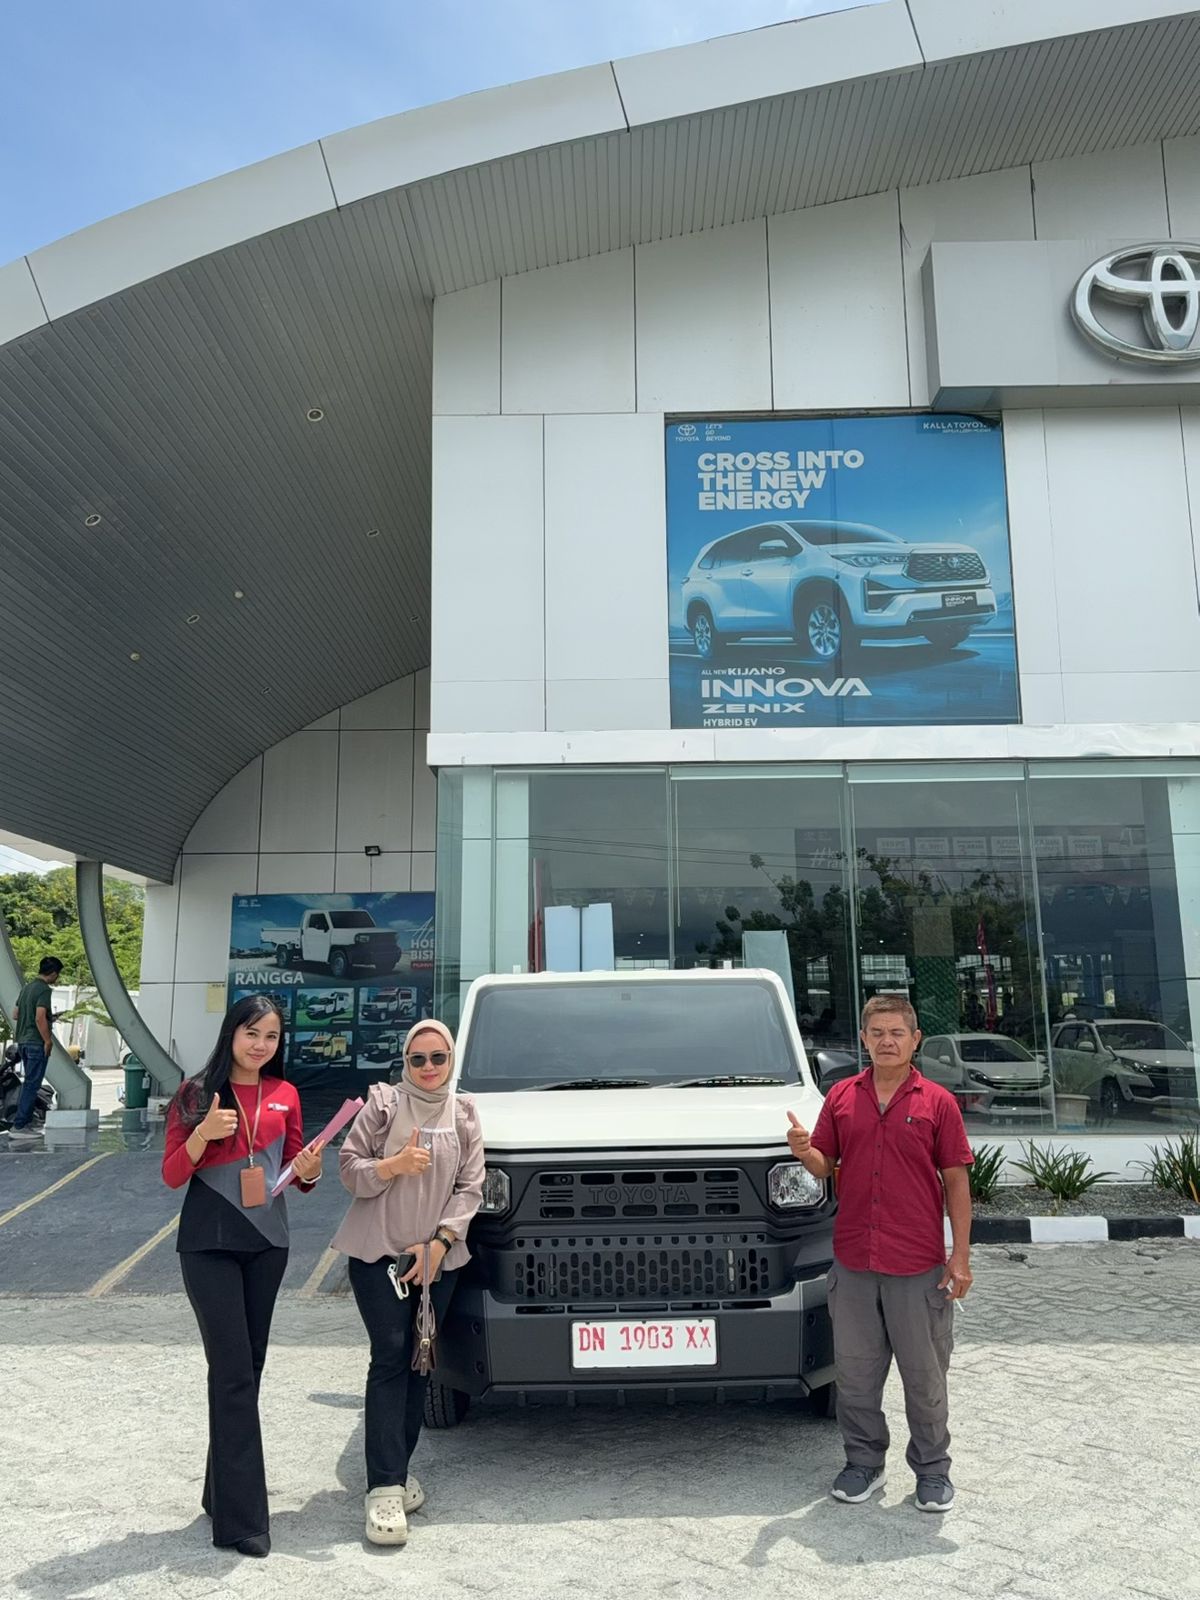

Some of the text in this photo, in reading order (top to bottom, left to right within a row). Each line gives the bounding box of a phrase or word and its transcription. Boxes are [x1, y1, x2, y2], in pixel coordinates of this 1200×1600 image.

[697, 449, 865, 471] CROSS INTO
[697, 470, 826, 491] THE NEW
[698, 490, 811, 511] ENERGY
[727, 667, 786, 676] KIJANG
[701, 678, 873, 698] INNOVA
[702, 702, 806, 714] ZENIX
[703, 718, 758, 727] HYBRID EV
[234, 971, 305, 985] RANGGA
[589, 1185, 690, 1204] TOYOTA
[578, 1325, 711, 1351] DN 1903 XX
